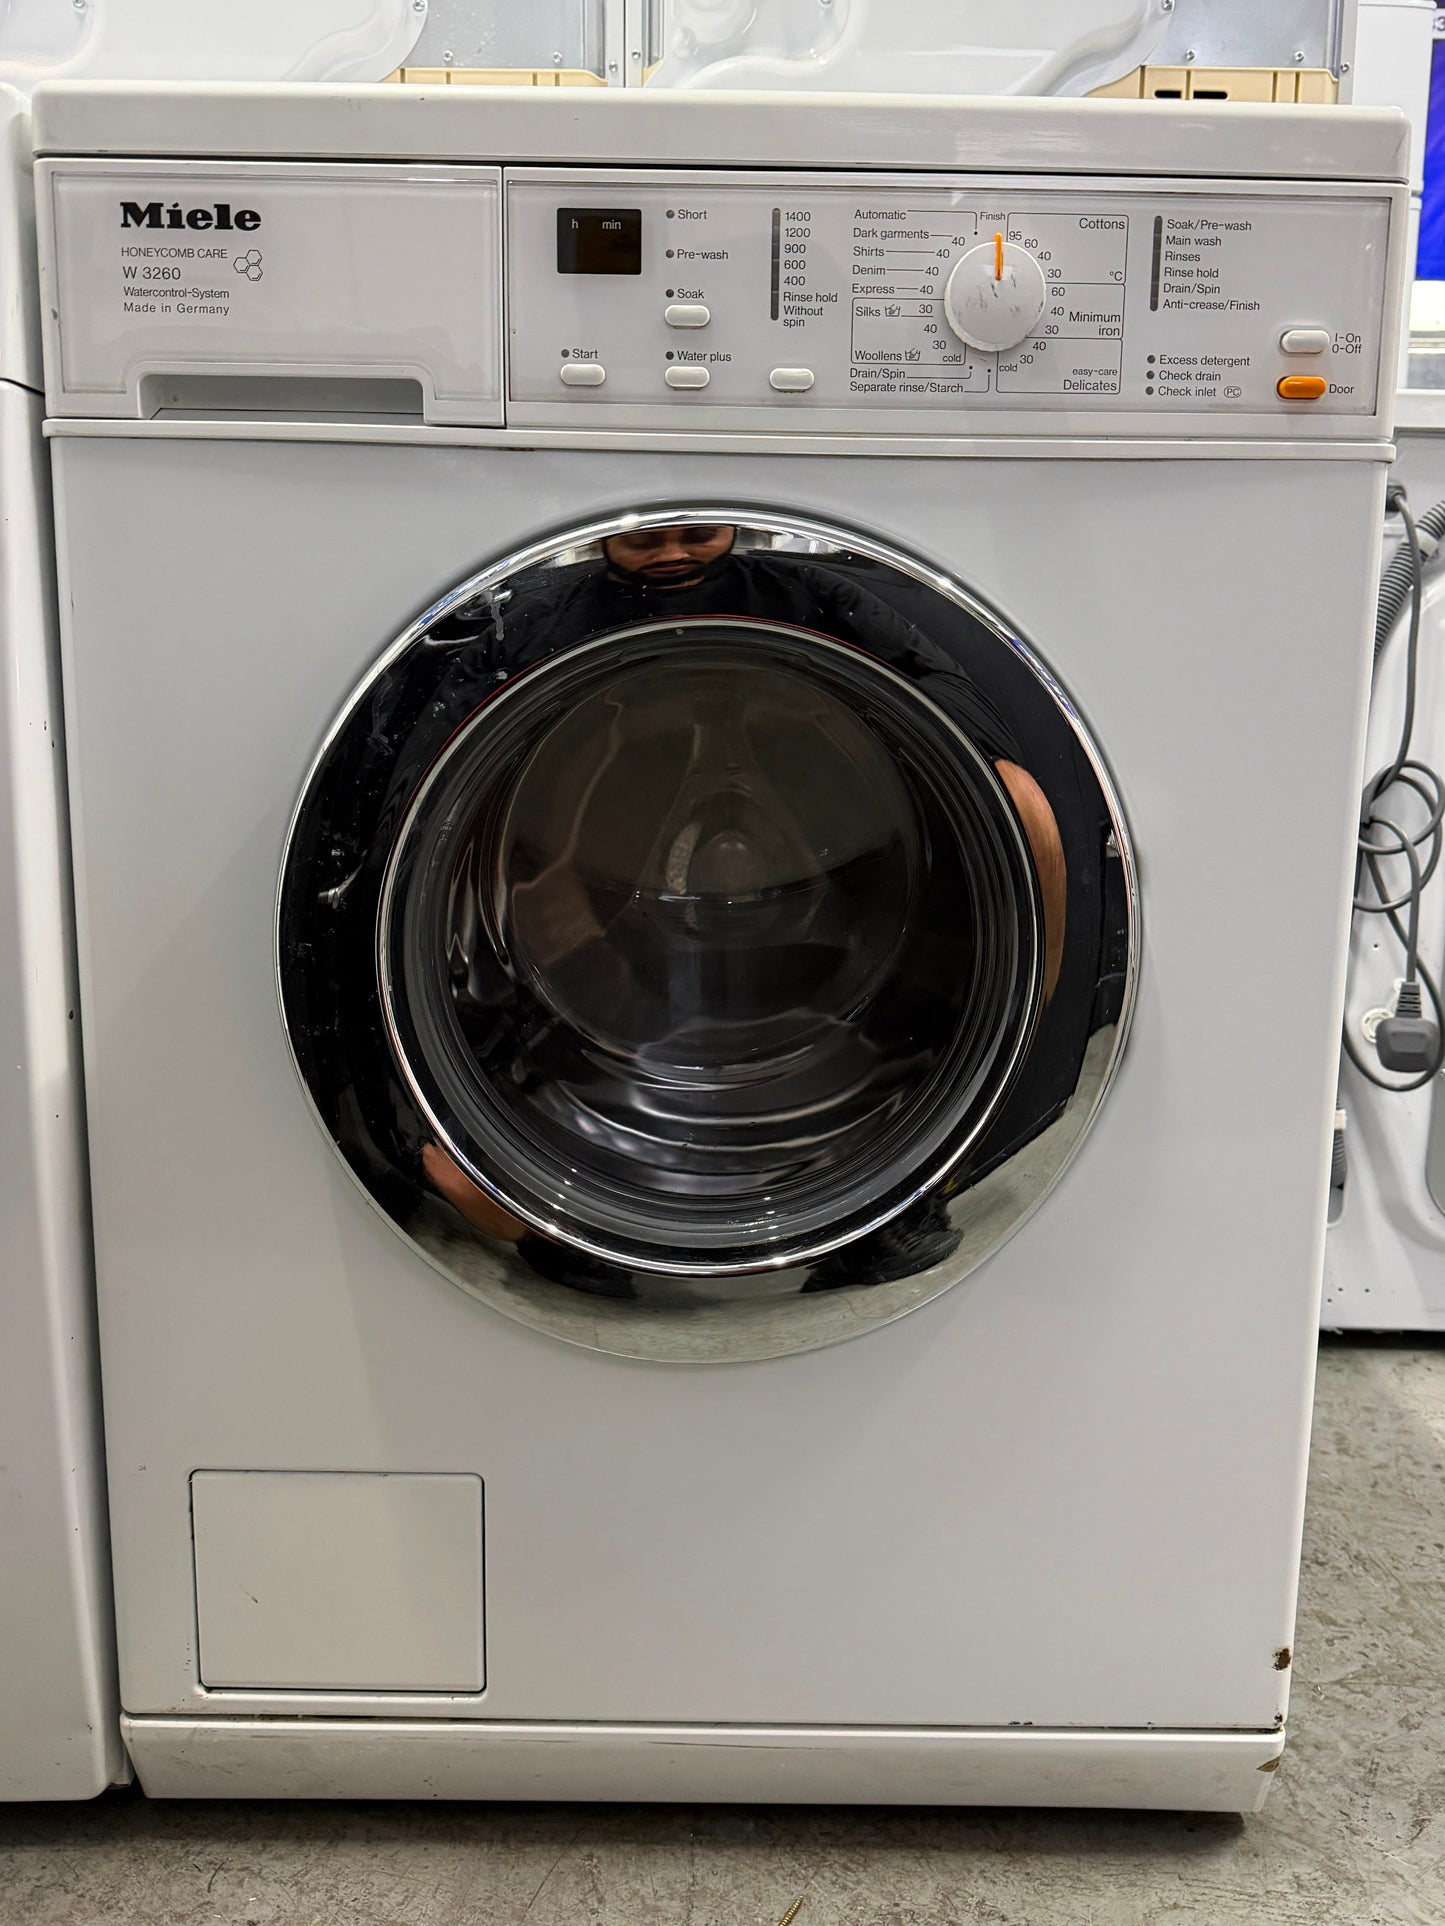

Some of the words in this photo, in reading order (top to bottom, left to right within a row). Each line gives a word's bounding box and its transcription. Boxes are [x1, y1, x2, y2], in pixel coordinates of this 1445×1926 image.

[119, 201, 261, 231] Miele
[677, 209, 707, 221] Short
[785, 212, 811, 222] 1400
[854, 209, 907, 220] Automatic
[979, 212, 1006, 221] Finish
[571, 219, 578, 229] h
[602, 219, 621, 230] min
[1079, 219, 1125, 230] Cottons
[1166, 219, 1252, 231] Soak/Pre-wash
[784, 228, 811, 238] 1200
[853, 228, 878, 239] Dark
[880, 229, 930, 240] garments
[1008, 231, 1022, 241] 95
[951, 237, 965, 247] 40
[1024, 238, 1039, 249] 60
[1165, 236, 1191, 246] Main
[1194, 236, 1222, 247] wash
[121, 246, 195, 259] HONEYCOMB
[197, 248, 228, 259] CARE
[784, 244, 806, 254] 900
[853, 246, 885, 257] Shirts
[936, 249, 950, 259] 40
[677, 250, 729, 260] Pre-wash
[1037, 251, 1052, 261] 40
[1164, 251, 1200, 262] Rinses
[784, 260, 806, 270] 600
[852, 265, 886, 276] Denim
[123, 265, 138, 280] W
[141, 266, 181, 281] 3260
[925, 266, 939, 276] 40
[1047, 268, 1061, 279] 30
[1109, 271, 1123, 282] °C
[1164, 267, 1194, 278] Rinse
[1196, 268, 1219, 279] hold
[784, 276, 806, 286] 400
[123, 286, 230, 300] Watercontrol-System
[677, 289, 704, 299] Soak
[851, 284, 895, 295] Express
[919, 285, 934, 295] 40
[1051, 287, 1066, 297] 60
[1163, 283, 1221, 295] Drain/Spin
[783, 292, 813, 303] Rinse
[815, 292, 838, 303] hold
[123, 301, 157, 314] Made
[160, 301, 172, 313] in
[176, 303, 230, 317] Germany
[918, 304, 933, 314] 30
[1162, 299, 1260, 311] Anti-crease/Finish
[784, 306, 823, 316] Without
[855, 306, 881, 317] Silks
[1050, 306, 1065, 316] 40
[783, 318, 805, 328] spin
[1068, 312, 1121, 323] Minimum
[923, 324, 938, 334] 40
[1045, 325, 1059, 335] 30
[1098, 325, 1121, 337] iron
[932, 340, 947, 350] 30
[1032, 341, 1047, 351] 40
[572, 349, 598, 359] Start
[677, 351, 707, 361] Water
[710, 352, 732, 363] plus
[854, 350, 902, 361] Woollens
[942, 353, 961, 363] cold
[1019, 354, 1034, 365] 30
[1159, 355, 1198, 366] Excess
[1200, 355, 1250, 368] detergent
[999, 363, 1018, 373] cold
[1072, 368, 1118, 377] easy-care
[849, 368, 906, 380] Drain/Spin
[1158, 370, 1193, 381] Check
[1195, 370, 1221, 381] drain
[849, 382, 897, 393] Separate
[899, 382, 964, 393] rinse/Starch
[1063, 380, 1117, 391] Delicates
[1328, 383, 1355, 395] Door
[1157, 386, 1193, 397] Check
[1194, 386, 1216, 397] inlet
